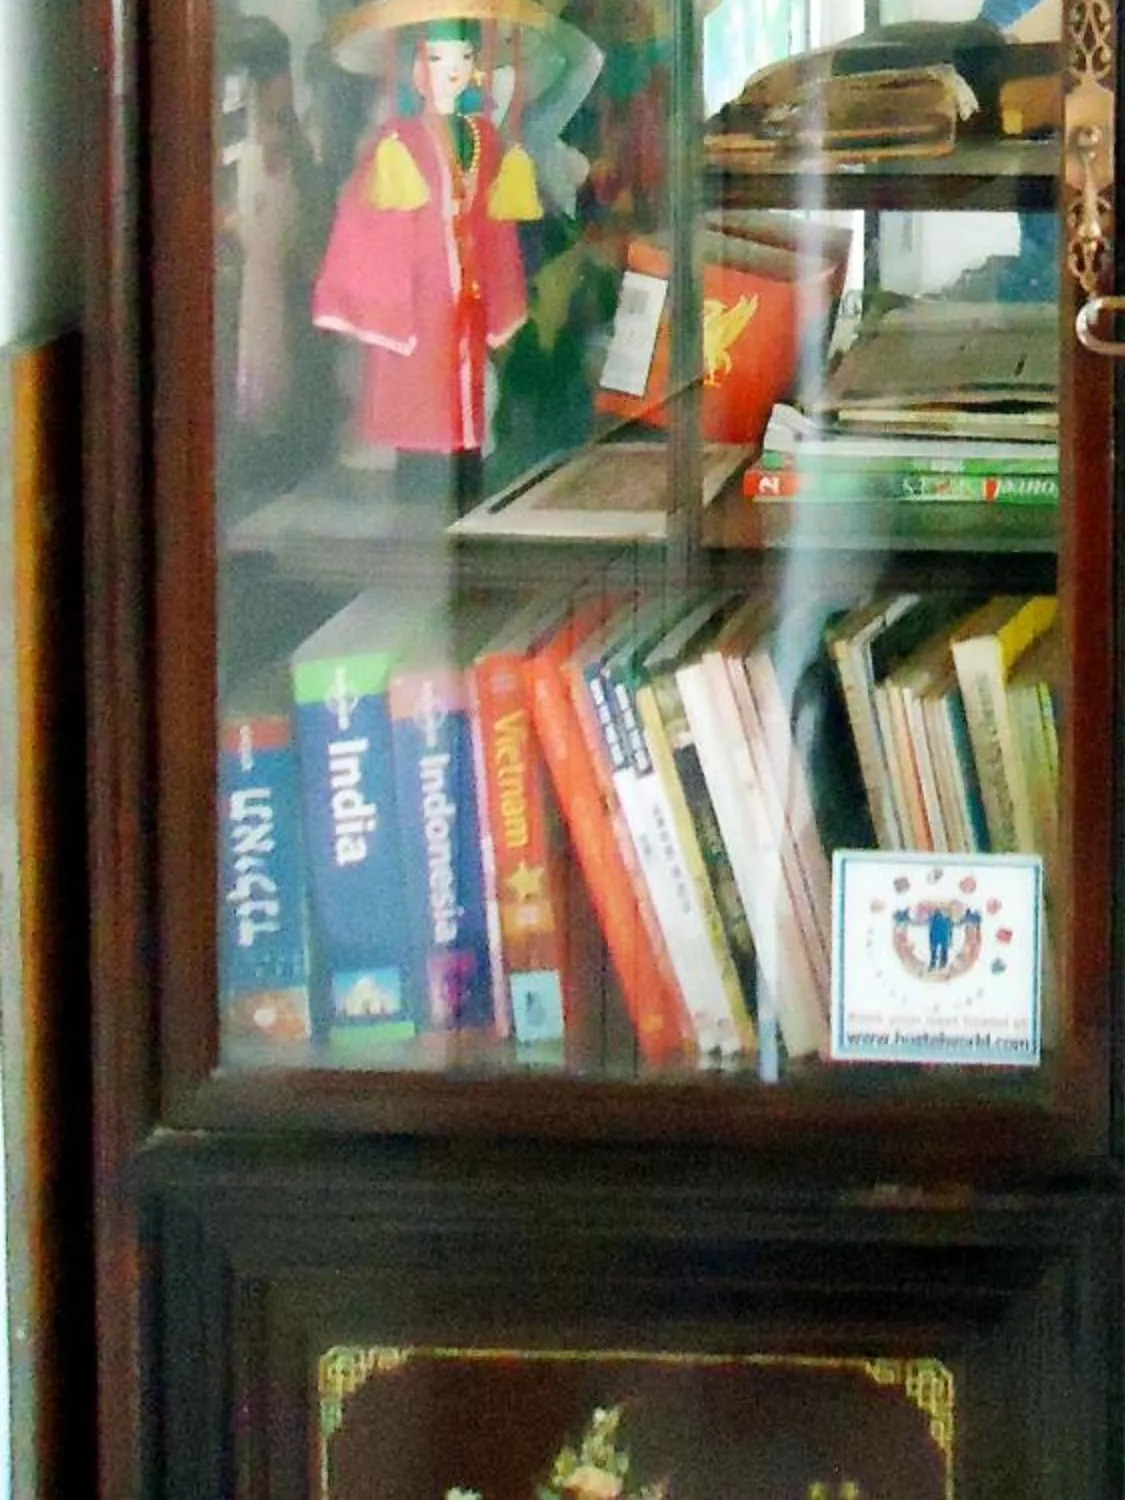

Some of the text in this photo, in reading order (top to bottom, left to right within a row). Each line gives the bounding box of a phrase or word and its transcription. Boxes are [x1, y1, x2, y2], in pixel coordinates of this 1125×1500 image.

[327, 737, 381, 867] India
[418, 754, 464, 944] Indonesia
[492, 710, 530, 850] Vietnam
